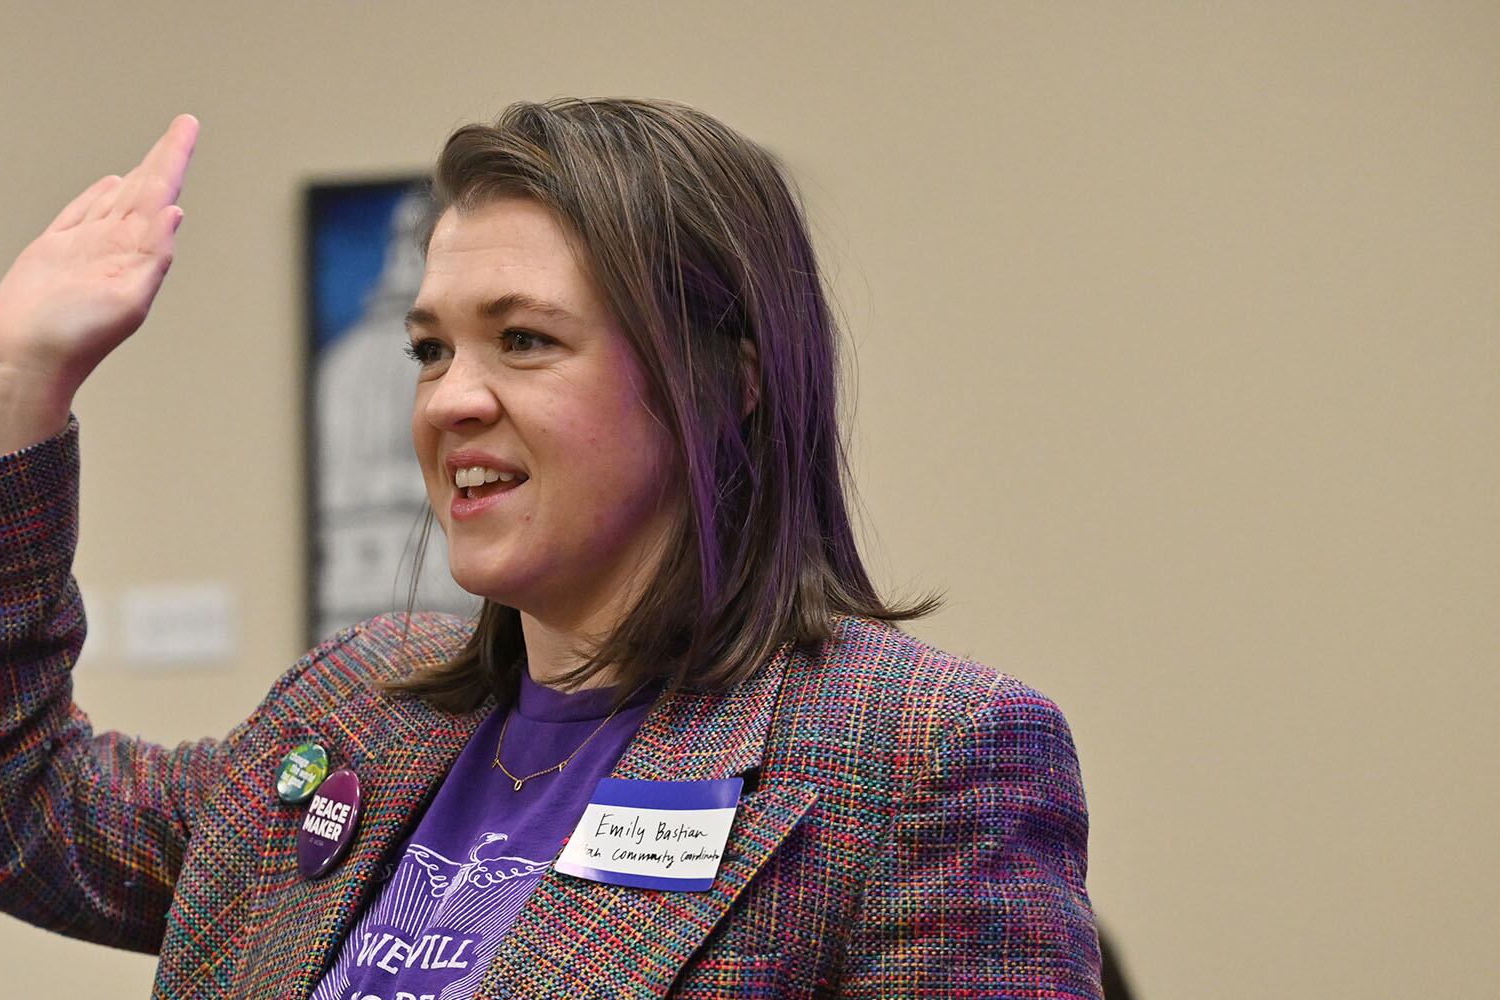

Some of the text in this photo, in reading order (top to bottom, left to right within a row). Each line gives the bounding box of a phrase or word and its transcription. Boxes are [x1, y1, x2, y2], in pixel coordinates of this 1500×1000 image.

[309, 795, 350, 825] PEACE
[302, 814, 342, 841] MAKER
[595, 813, 708, 844] Emily Bastian
[357, 932, 412, 975] WE
